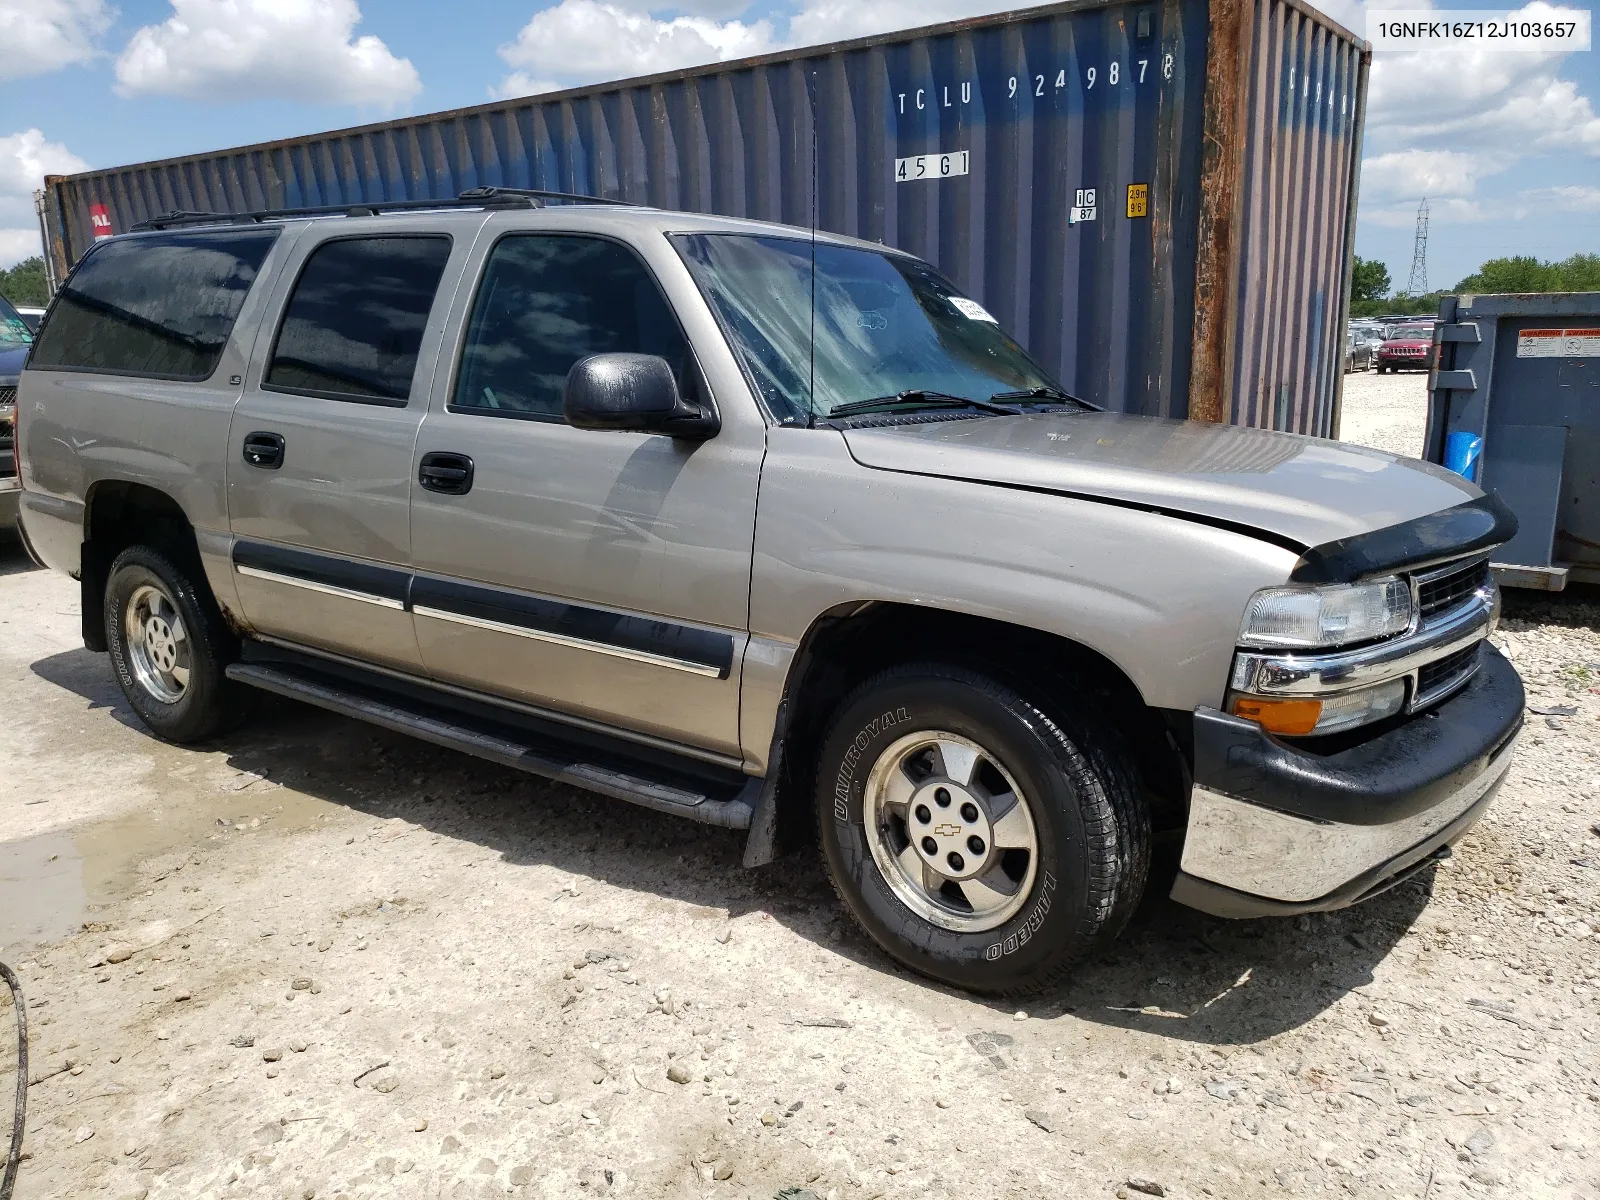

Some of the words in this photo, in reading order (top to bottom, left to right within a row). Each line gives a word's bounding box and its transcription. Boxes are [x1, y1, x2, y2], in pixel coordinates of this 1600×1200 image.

[898, 82, 971, 114] TCLU
[1080, 208, 1093, 219] 87
[107, 594, 133, 686] UNIROYAL
[833, 706, 912, 822] UNIROYAL
[985, 870, 1058, 961] LAREDO
